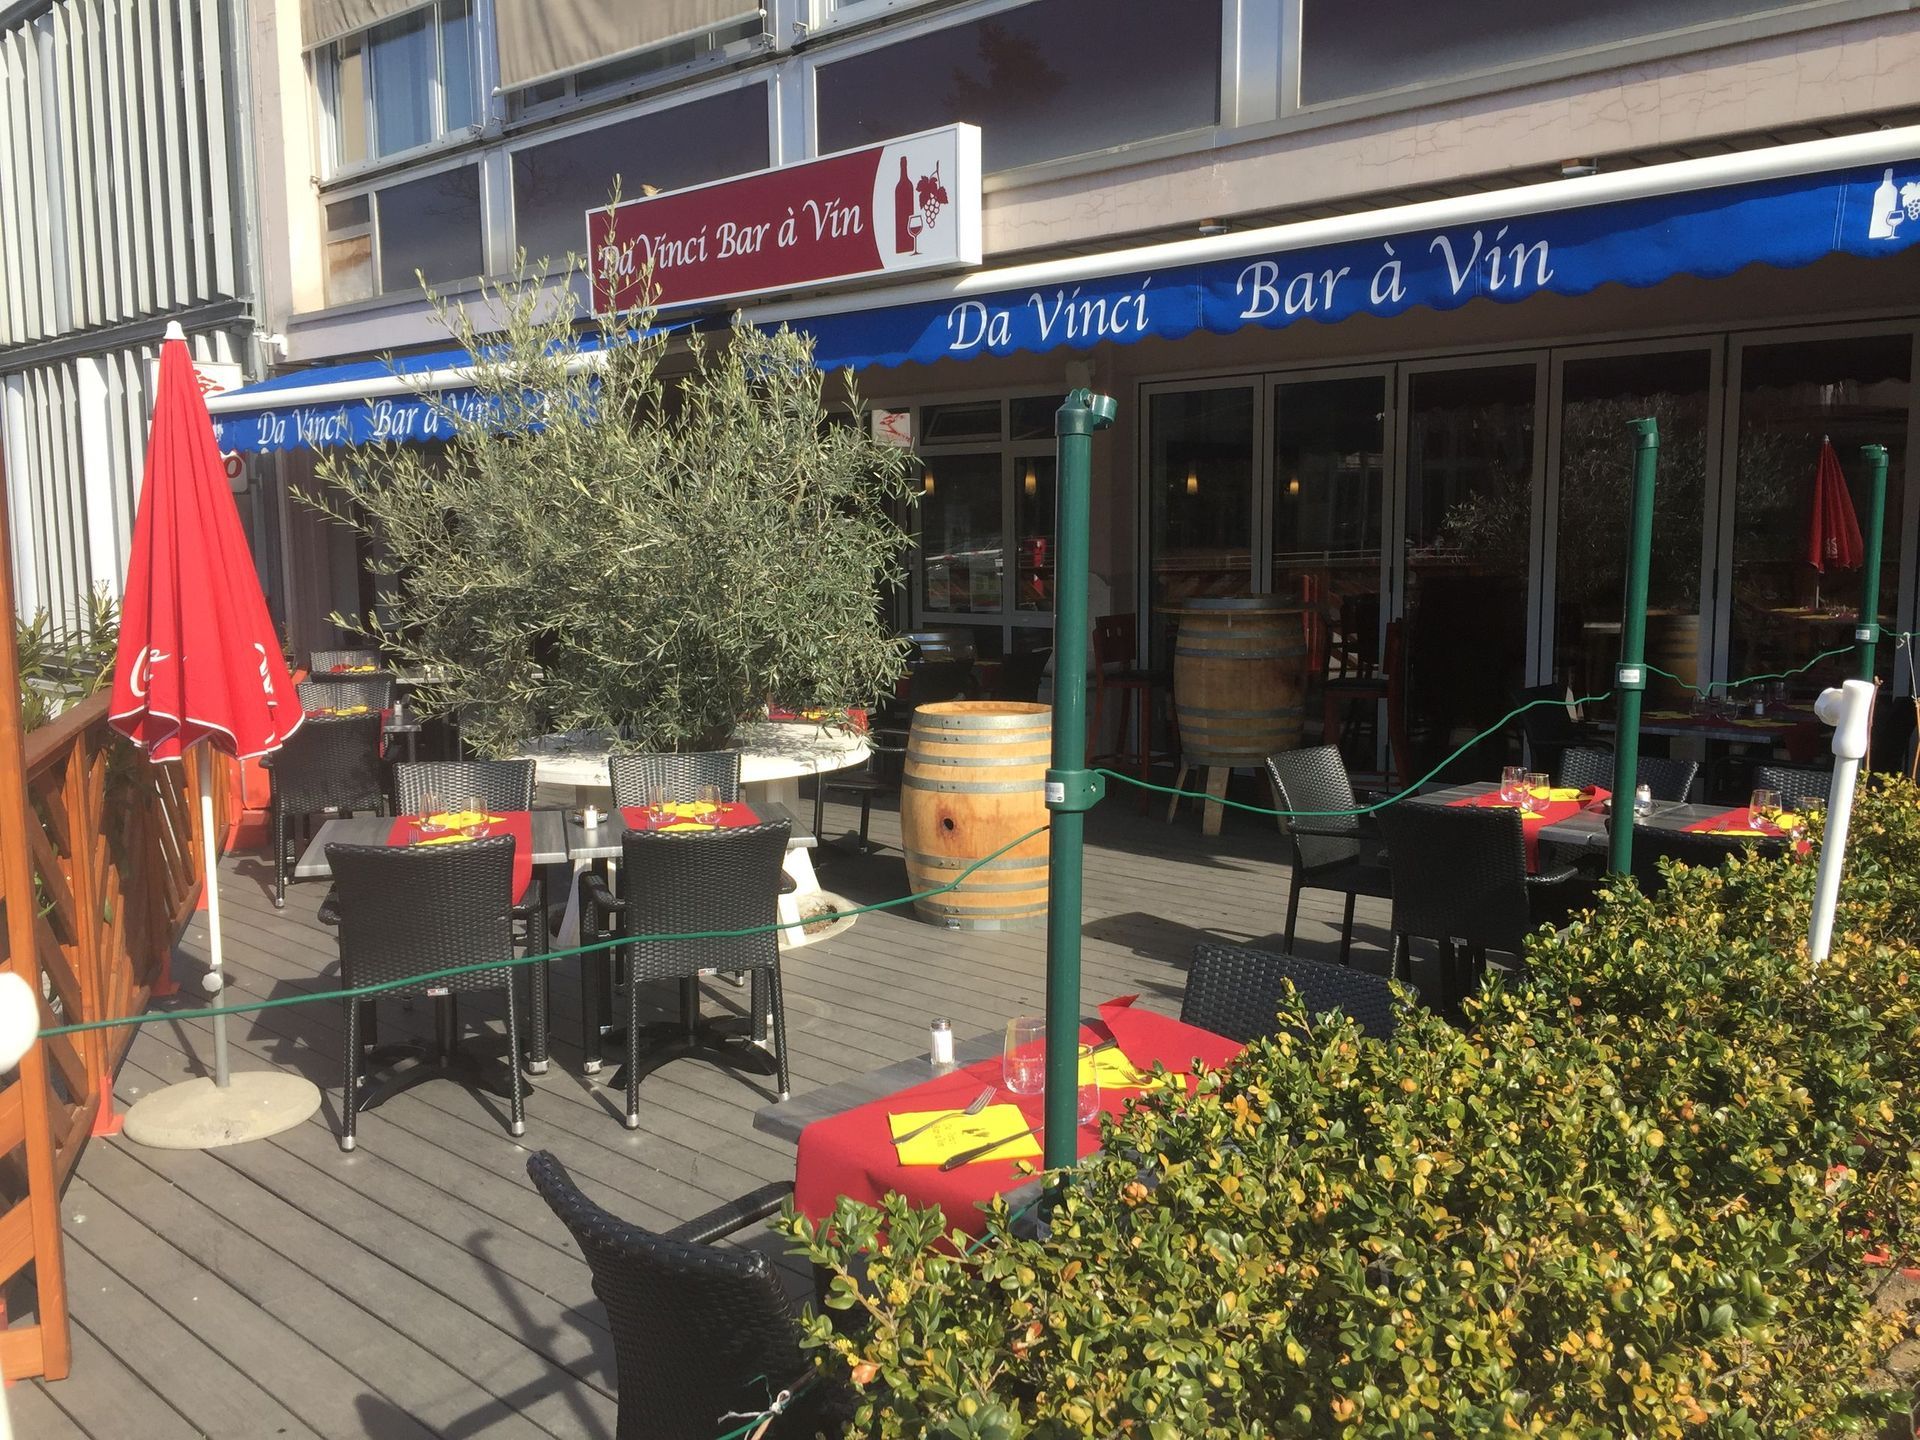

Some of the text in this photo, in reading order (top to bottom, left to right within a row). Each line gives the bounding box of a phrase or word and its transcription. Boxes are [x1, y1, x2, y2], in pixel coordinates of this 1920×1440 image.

[600, 197, 864, 280] Da Vinci Bar à Vin
[947, 225, 1554, 350] Da Vinci Bar à Vin
[257, 411, 286, 445] Da
[292, 404, 345, 442] Vinci
[373, 399, 419, 436] Bar
